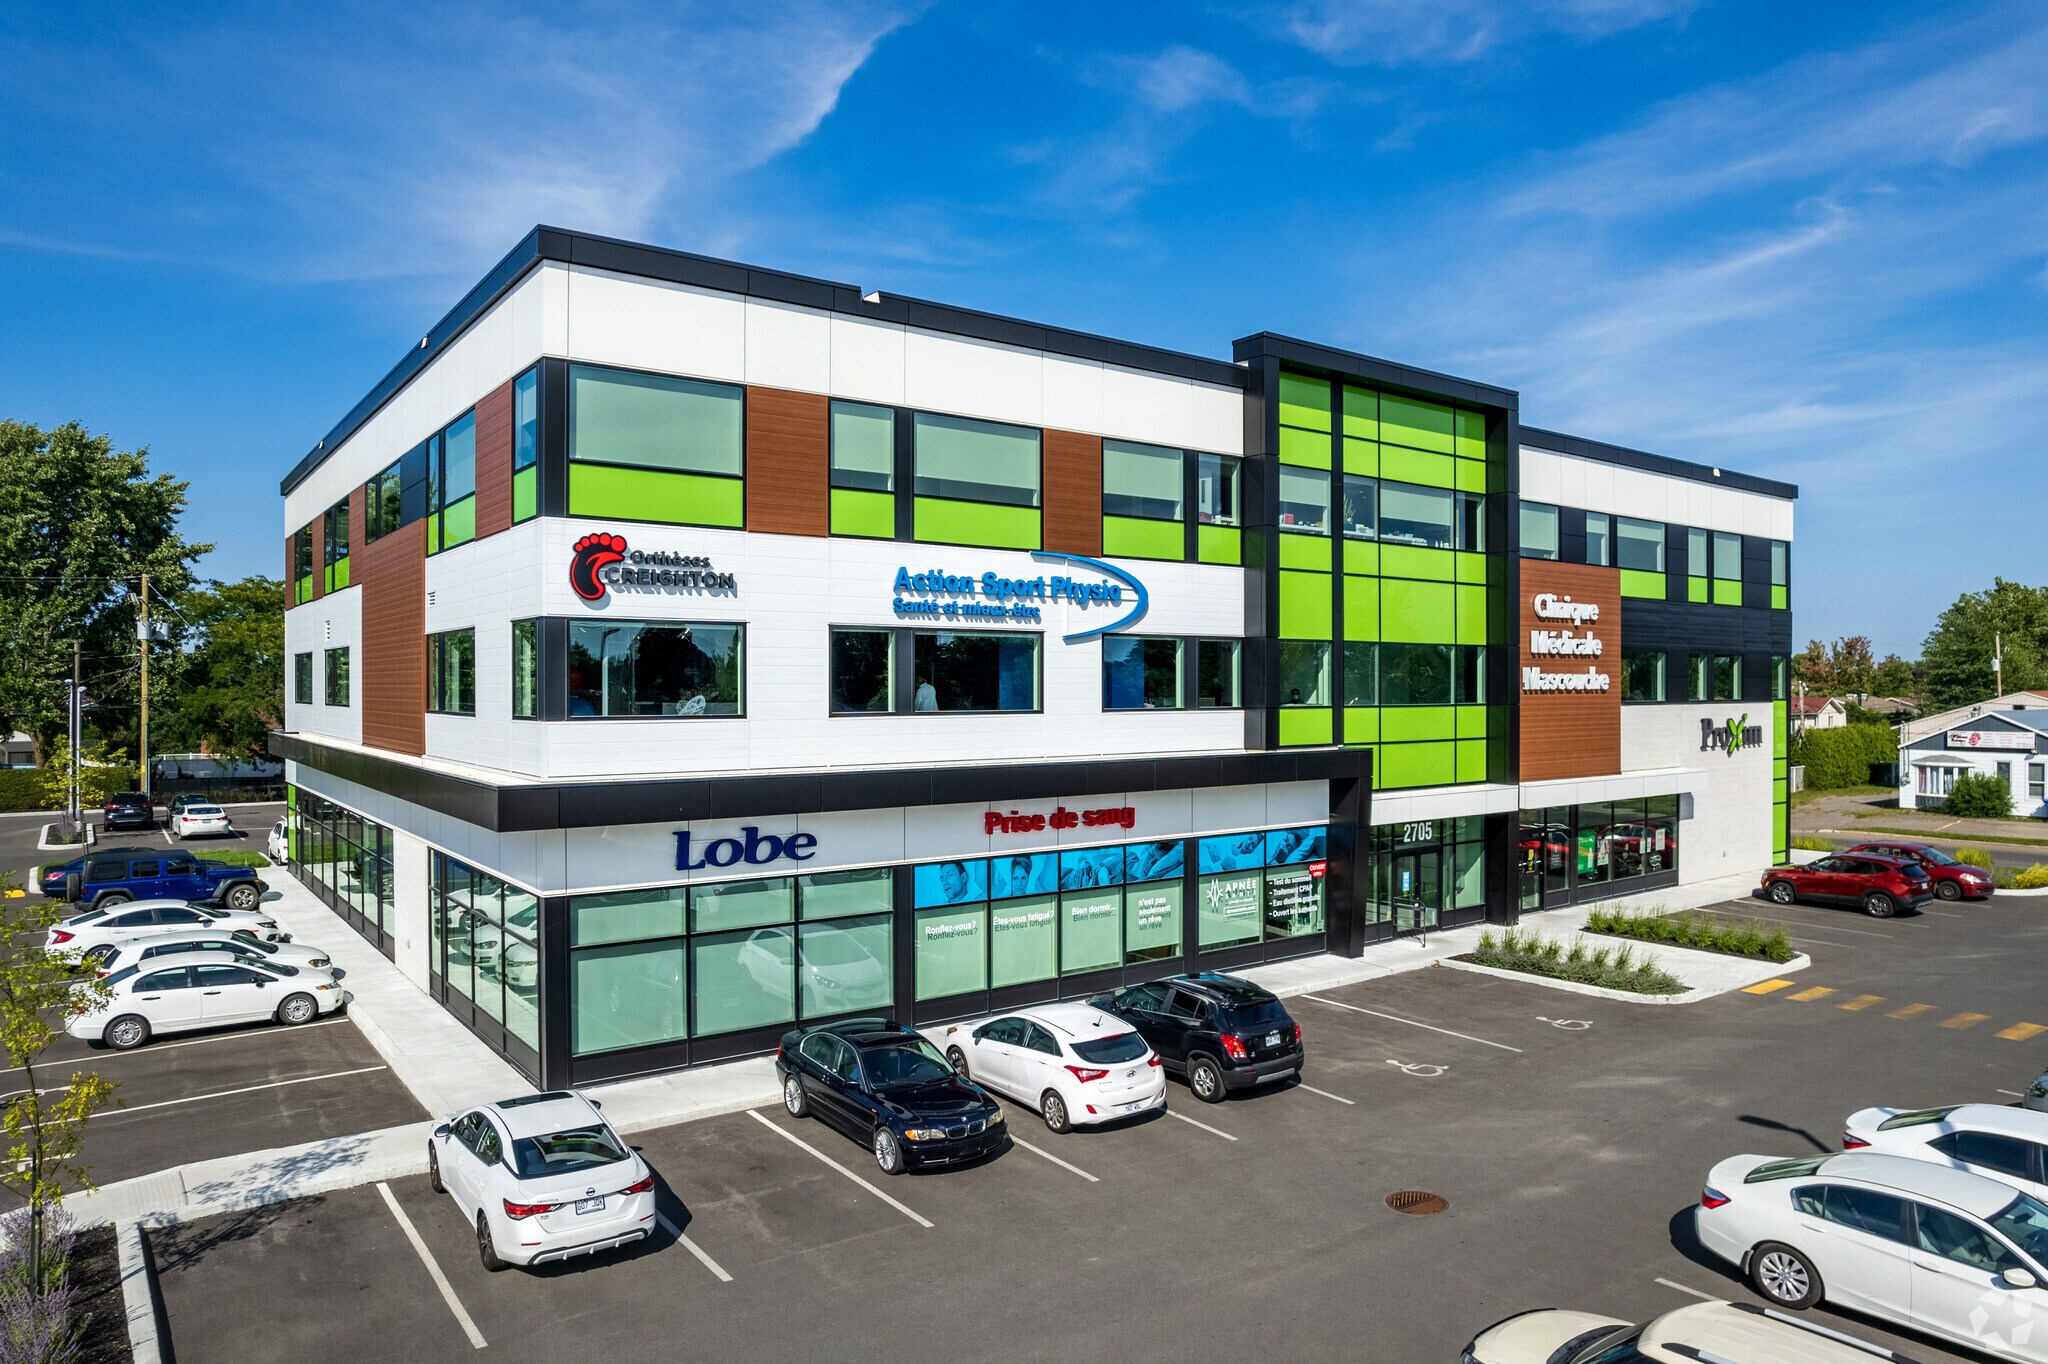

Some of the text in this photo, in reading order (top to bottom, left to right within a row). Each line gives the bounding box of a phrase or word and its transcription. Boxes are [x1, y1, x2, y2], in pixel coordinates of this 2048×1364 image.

[630, 550, 710, 568] Orthèses
[605, 567, 734, 588] CREIGHTON
[893, 567, 1122, 604] Action Sport Physio
[893, 597, 939, 613] Santé
[942, 601, 959, 614] et
[1534, 593, 1599, 625] Clinique
[1531, 630, 1602, 655] Médicale
[1522, 666, 1610, 690] Mascouche
[985, 807, 1135, 835] Prise de sang
[1403, 822, 1432, 843] 2705
[672, 826, 818, 870] Lobe
[1225, 878, 1257, 893] APNÉE
[1273, 878, 1284, 886] Test
[1299, 884, 1313, 892] CPAP
[1155, 897, 1167, 905] pas
[1273, 899, 1283, 907] Eau
[1027, 910, 1055, 923] fatigué?
[1072, 906, 1088, 916] Bien
[1273, 908, 1290, 917] Ouvert
[925, 920, 977, 935] Ronflez-vous?
